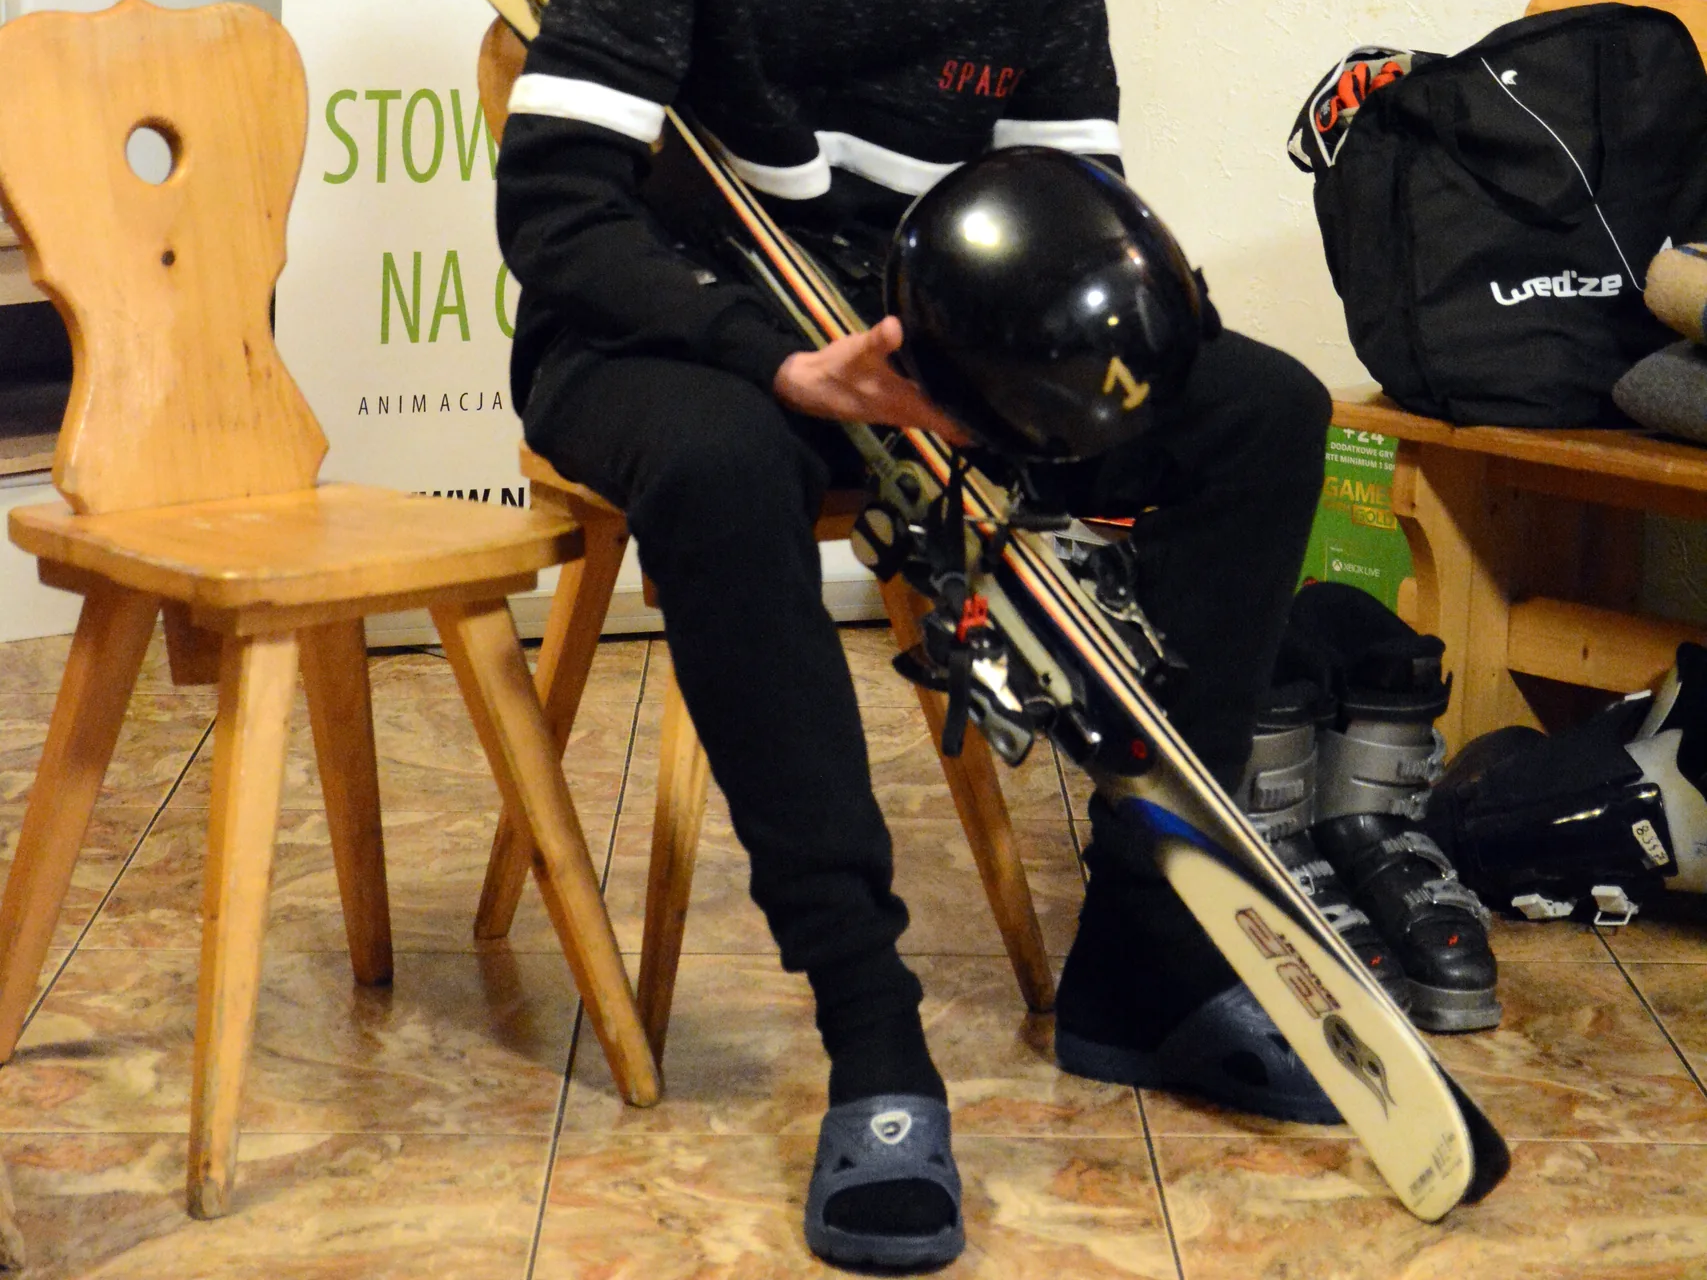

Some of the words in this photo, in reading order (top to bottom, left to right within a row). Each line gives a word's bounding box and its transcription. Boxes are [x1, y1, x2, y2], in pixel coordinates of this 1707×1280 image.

[380, 250, 471, 344] NA
[358, 391, 503, 416] ANIMACJA
[1330, 442, 1377, 456] DODATKOWE
[1378, 450, 1394, 459] GRY
[1339, 455, 1377, 468] MINIMUM
